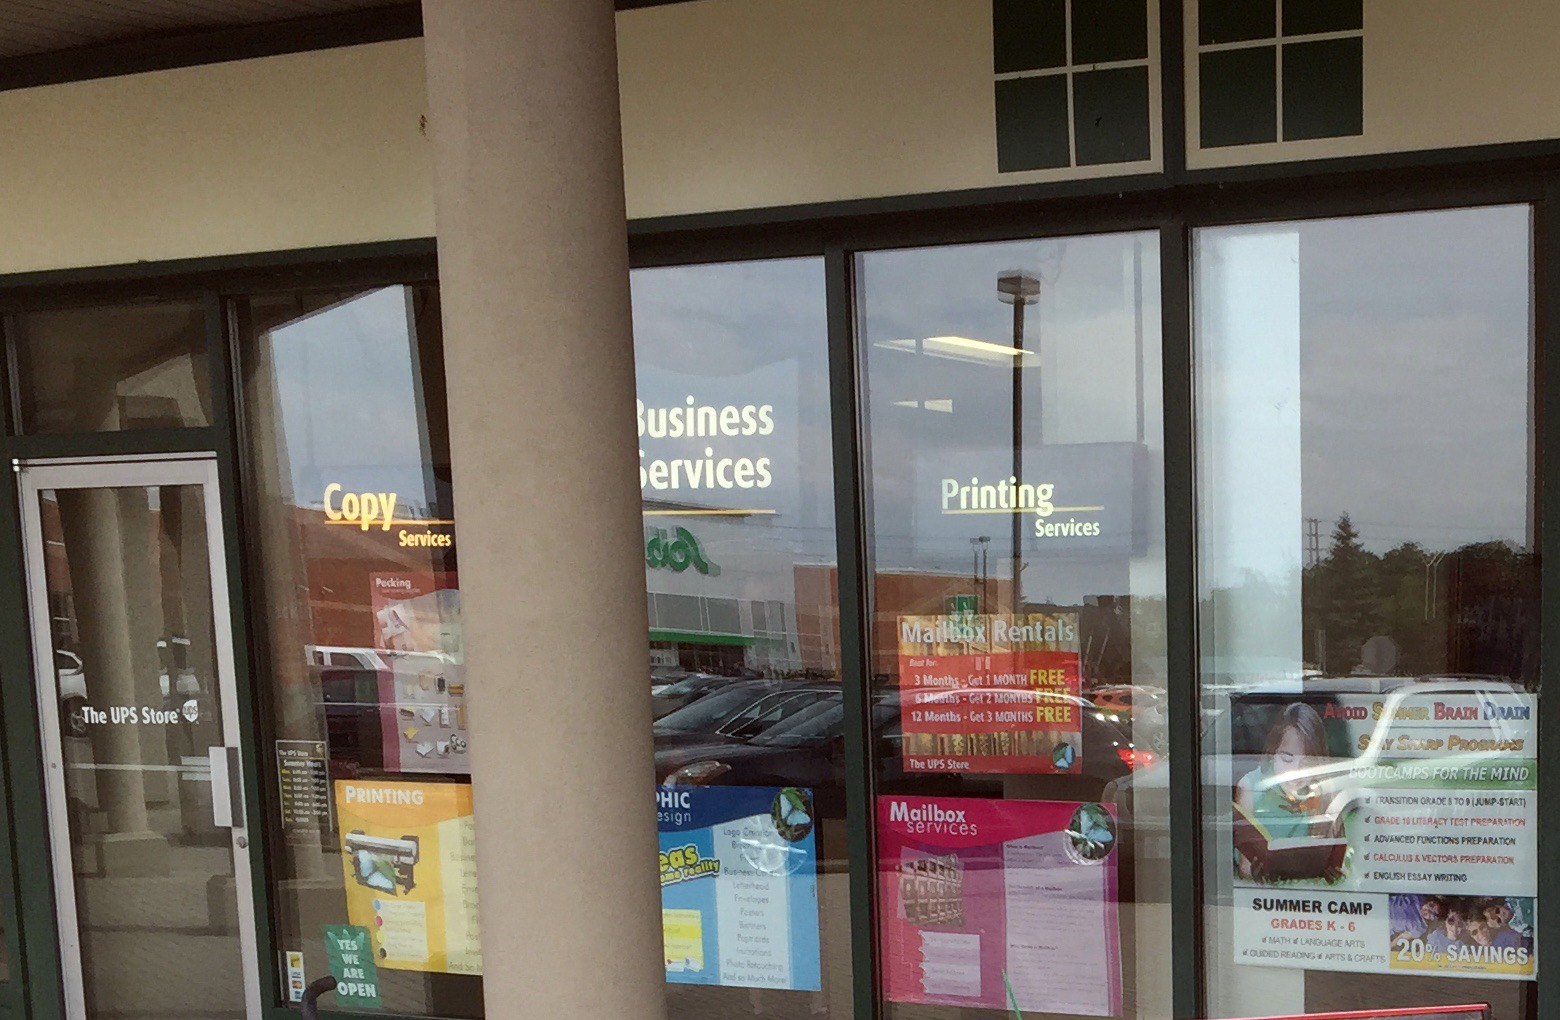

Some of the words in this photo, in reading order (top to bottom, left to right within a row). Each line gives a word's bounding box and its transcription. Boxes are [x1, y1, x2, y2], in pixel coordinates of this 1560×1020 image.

[942, 476, 1055, 517] Printing
[323, 482, 398, 531] Copy
[1035, 517, 1101, 538] Services
[398, 529, 452, 547] Services
[901, 619, 987, 643] Mailbox
[993, 618, 1075, 642] Rentals
[914, 674, 921, 686] 3
[967, 674, 983, 686] Get
[993, 673, 1028, 686] MONTH
[1029, 669, 1066, 686] FREE
[82, 706, 107, 724] The
[110, 706, 139, 724] UPS
[141, 706, 179, 724] Store
[911, 711, 923, 722] 12
[925, 711, 962, 723] Months
[969, 711, 985, 723] Get
[986, 712, 993, 723] 3
[995, 711, 1034, 723] MONTHS
[1036, 706, 1072, 723] FREE
[1323, 701, 1368, 720] AVOID
[1434, 701, 1478, 720] BRAIN
[1483, 701, 1531, 721] DRAIN
[1358, 734, 1393, 751] SAY
[909, 758, 925, 769] The
[928, 759, 945, 769] UPS
[947, 759, 970, 770] Store
[1349, 764, 1428, 780] BOOTCAMPS
[1432, 766, 1459, 780] FOR
[1462, 766, 1487, 780] THE
[1490, 767, 1530, 781] MIND
[344, 785, 425, 805] PRINTING
[1420, 797, 1447, 806] GRADE
[889, 801, 967, 823] Mailbox
[906, 821, 978, 836] services
[1374, 816, 1400, 825] GRADE
[1450, 817, 1469, 827] TEST
[1471, 817, 1526, 828] PREPARATION
[1374, 835, 1416, 845] ADVANCED
[1416, 836, 1460, 845] FUNCTIONS
[1461, 837, 1516, 846] PREPARATION
[1373, 853, 1413, 863] CALCULUS
[1422, 854, 1459, 864] VECTORS
[1460, 855, 1515, 865] PREPARATION
[1373, 871, 1406, 881] ENGLISH
[1407, 872, 1433, 882] ESSAY
[1434, 872, 1468, 883] WRITING
[1252, 897, 1323, 914] SUMMER
[1327, 900, 1374, 916] CAMP
[1270, 918, 1323, 931] GRADES
[1326, 920, 1337, 931] K
[1347, 921, 1356, 932] 6
[336, 939, 359, 951] YES
[1268, 936, 1292, 945] MATH
[341, 953, 360, 965] WE
[1396, 938, 1442, 962] 20%
[1446, 944, 1530, 966] SAVINGS
[343, 968, 365, 980] ARE
[336, 982, 377, 998] OPEN
